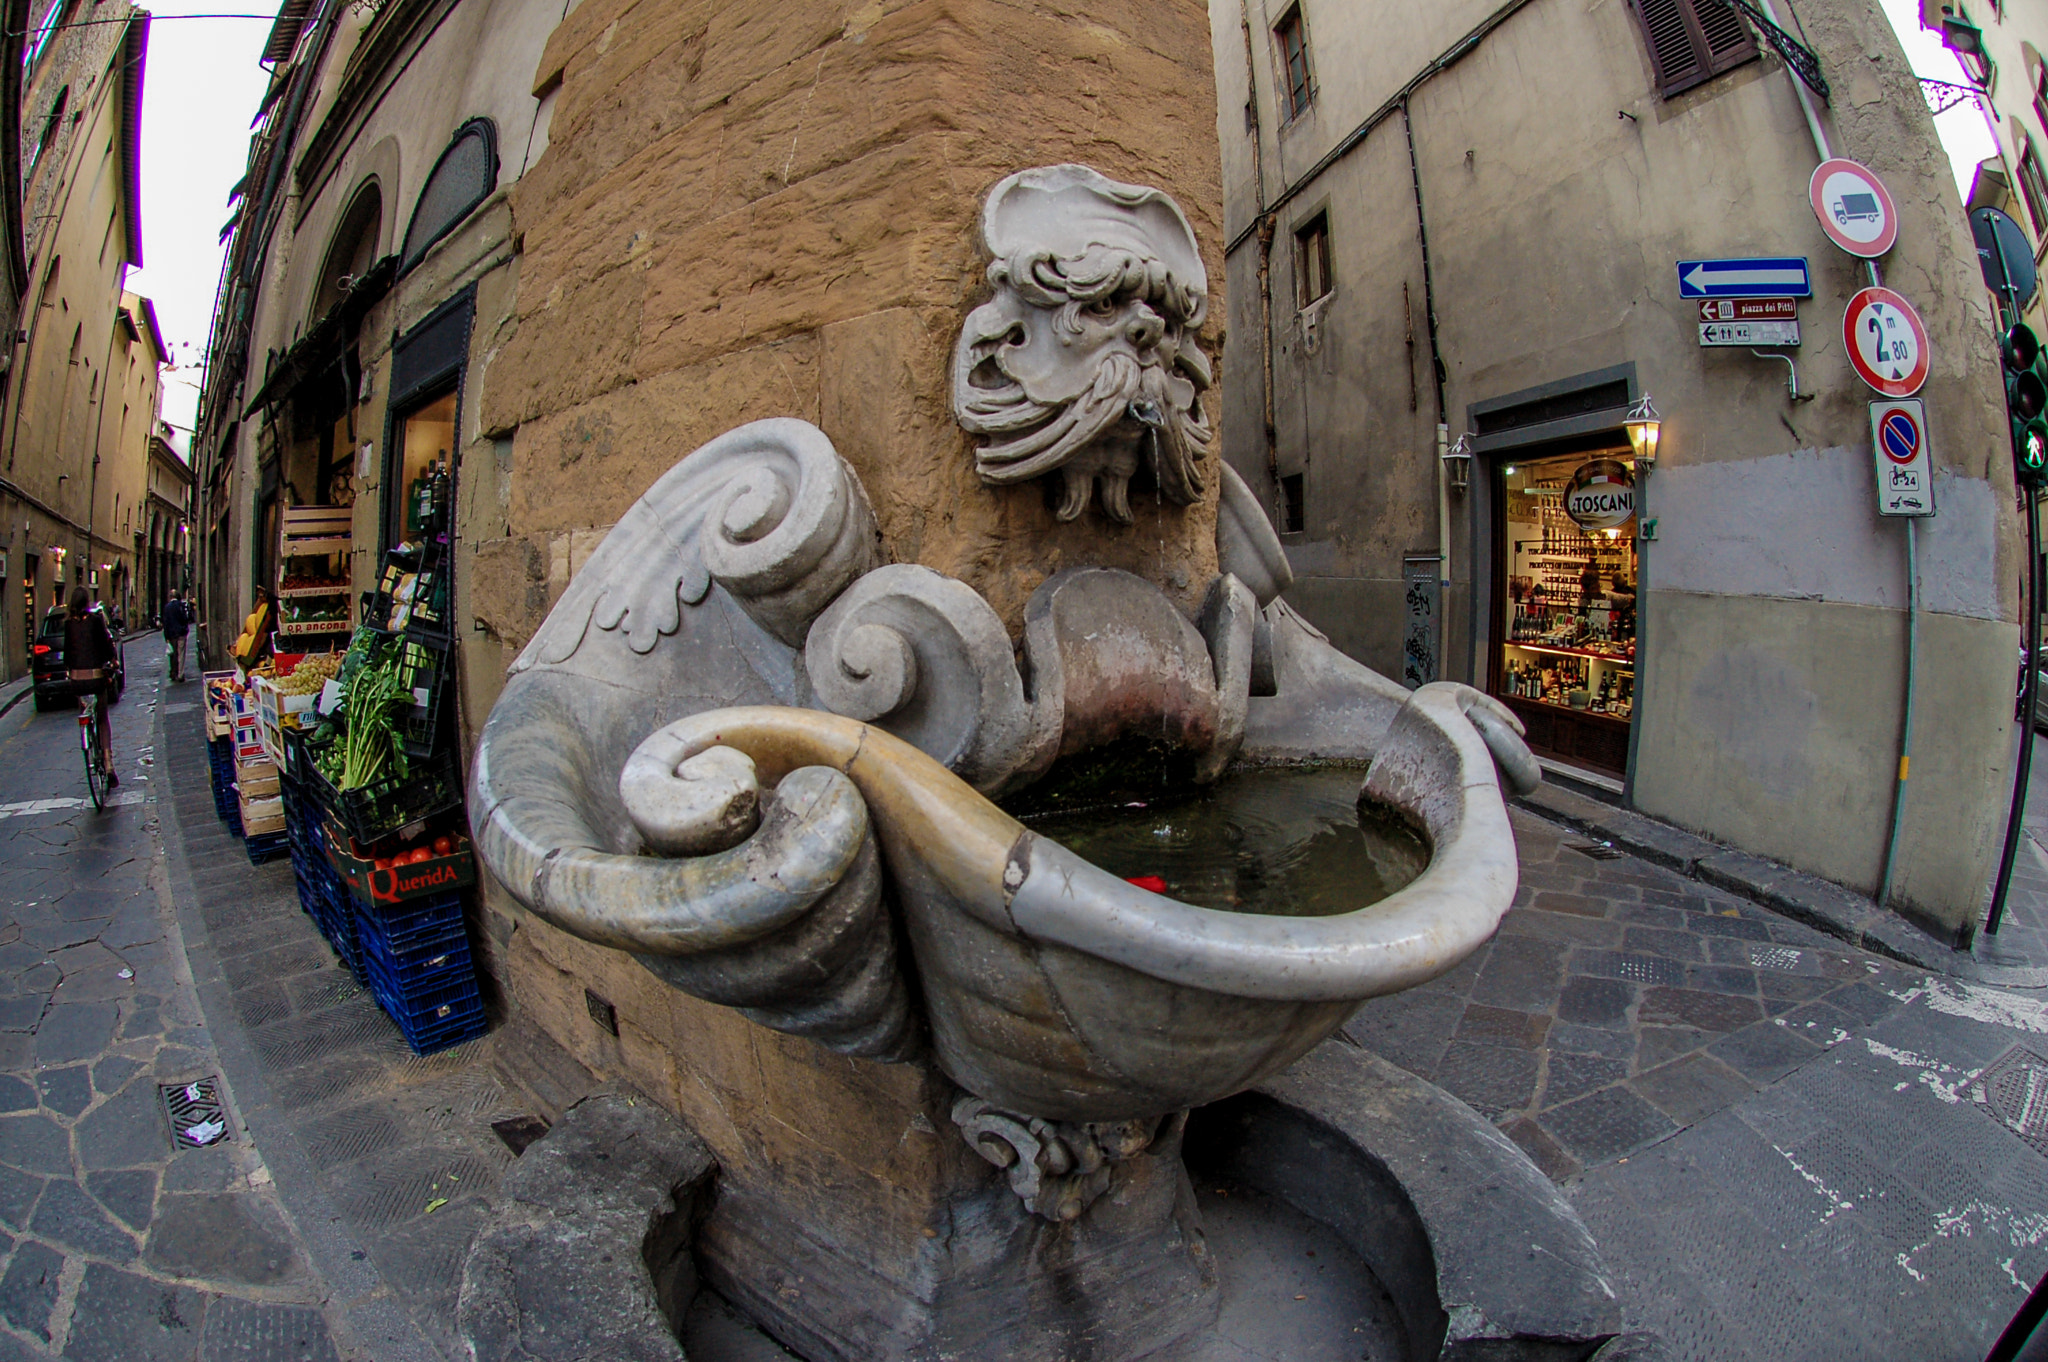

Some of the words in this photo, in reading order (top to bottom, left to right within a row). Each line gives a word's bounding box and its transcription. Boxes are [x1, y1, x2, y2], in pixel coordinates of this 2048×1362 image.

[1741, 304, 1763, 315] piazza
[1765, 303, 1776, 312] dei
[1777, 302, 1793, 312] Pitti
[1886, 317, 1896, 329] m
[306, 622, 347, 631] ancona
[368, 865, 458, 903] QueridA
